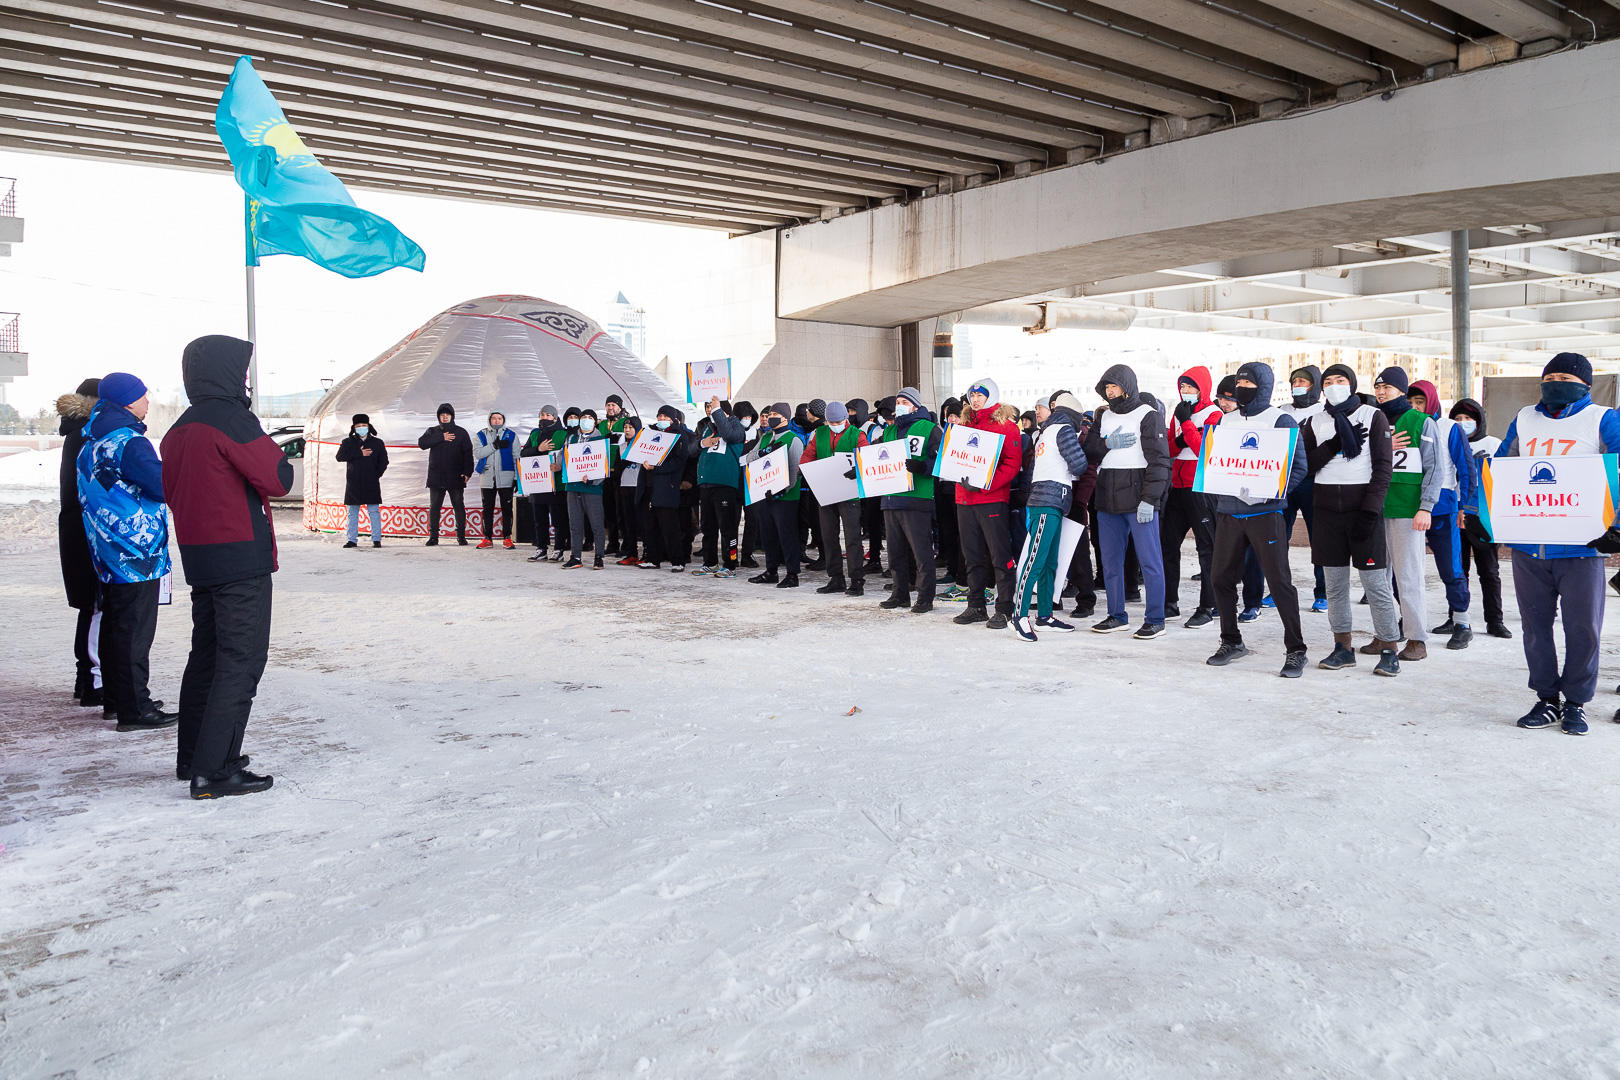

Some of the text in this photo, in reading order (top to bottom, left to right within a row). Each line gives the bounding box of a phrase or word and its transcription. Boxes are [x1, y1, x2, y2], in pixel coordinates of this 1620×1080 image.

[1526, 437, 1577, 457] 117
[1208, 456, 1281, 471] САРЫАРҚА
[1393, 450, 1408, 470] 2
[1511, 493, 1579, 507] БАРЫС
